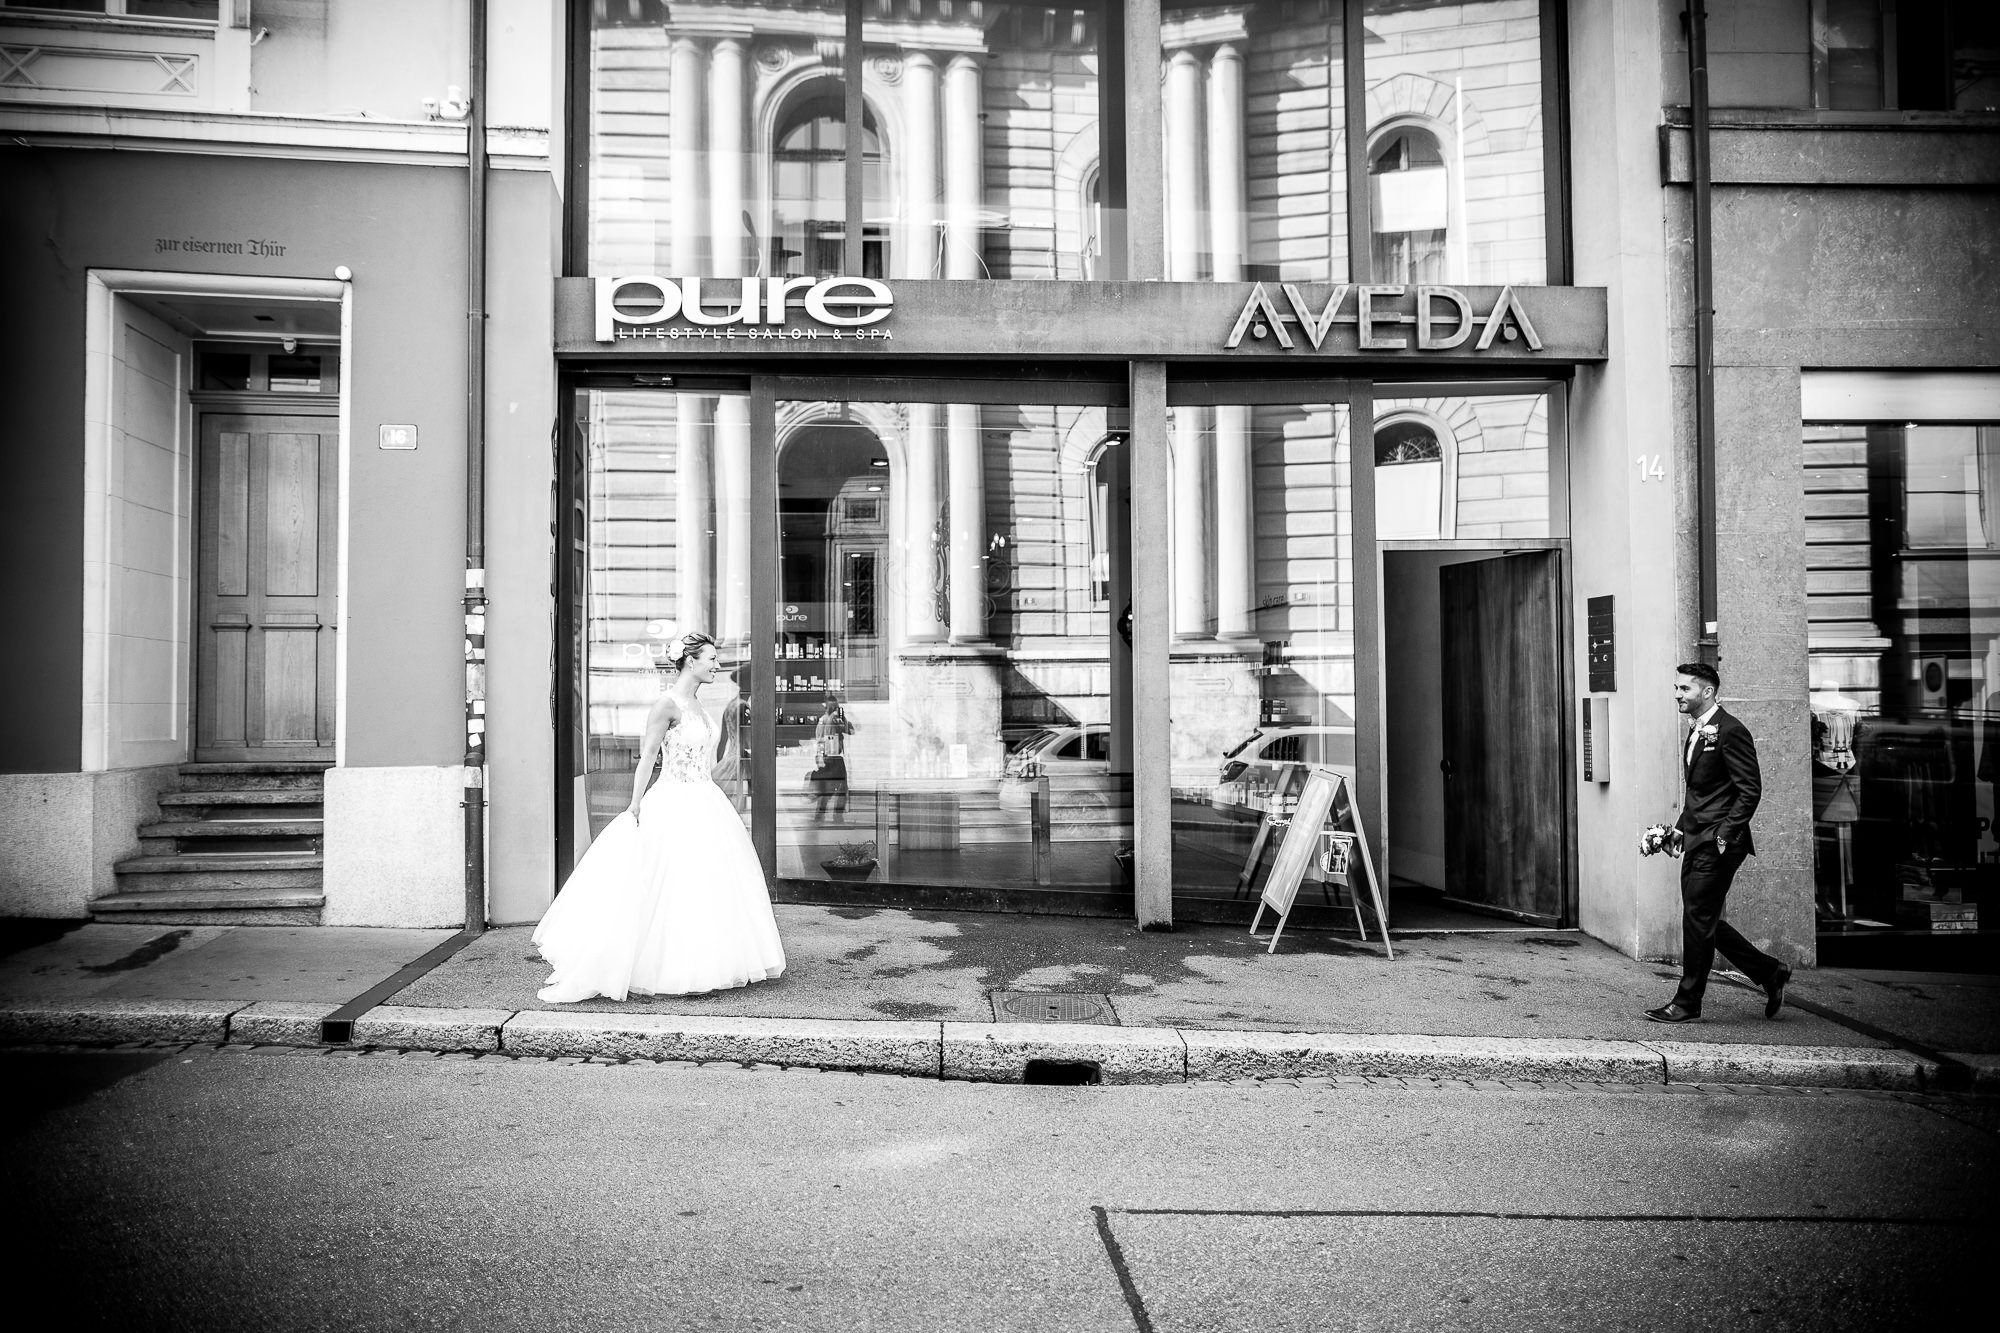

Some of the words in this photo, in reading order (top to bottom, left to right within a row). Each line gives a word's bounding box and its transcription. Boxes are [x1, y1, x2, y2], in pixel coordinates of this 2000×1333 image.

[154, 238, 180, 254] zur
[182, 236, 243, 255] eisernen
[246, 238, 287, 259] Thür
[595, 276, 894, 341] pure
[1223, 281, 1544, 352] AVEDA
[618, 328, 736, 339] LIFESTYLE
[748, 328, 817, 340] SALON
[832, 328, 843, 340] &
[855, 328, 894, 340] SPA
[390, 429, 407, 444] 16
[1636, 454, 1665, 481] 14
[776, 614, 808, 623] pure
[622, 643, 667, 661] pu
